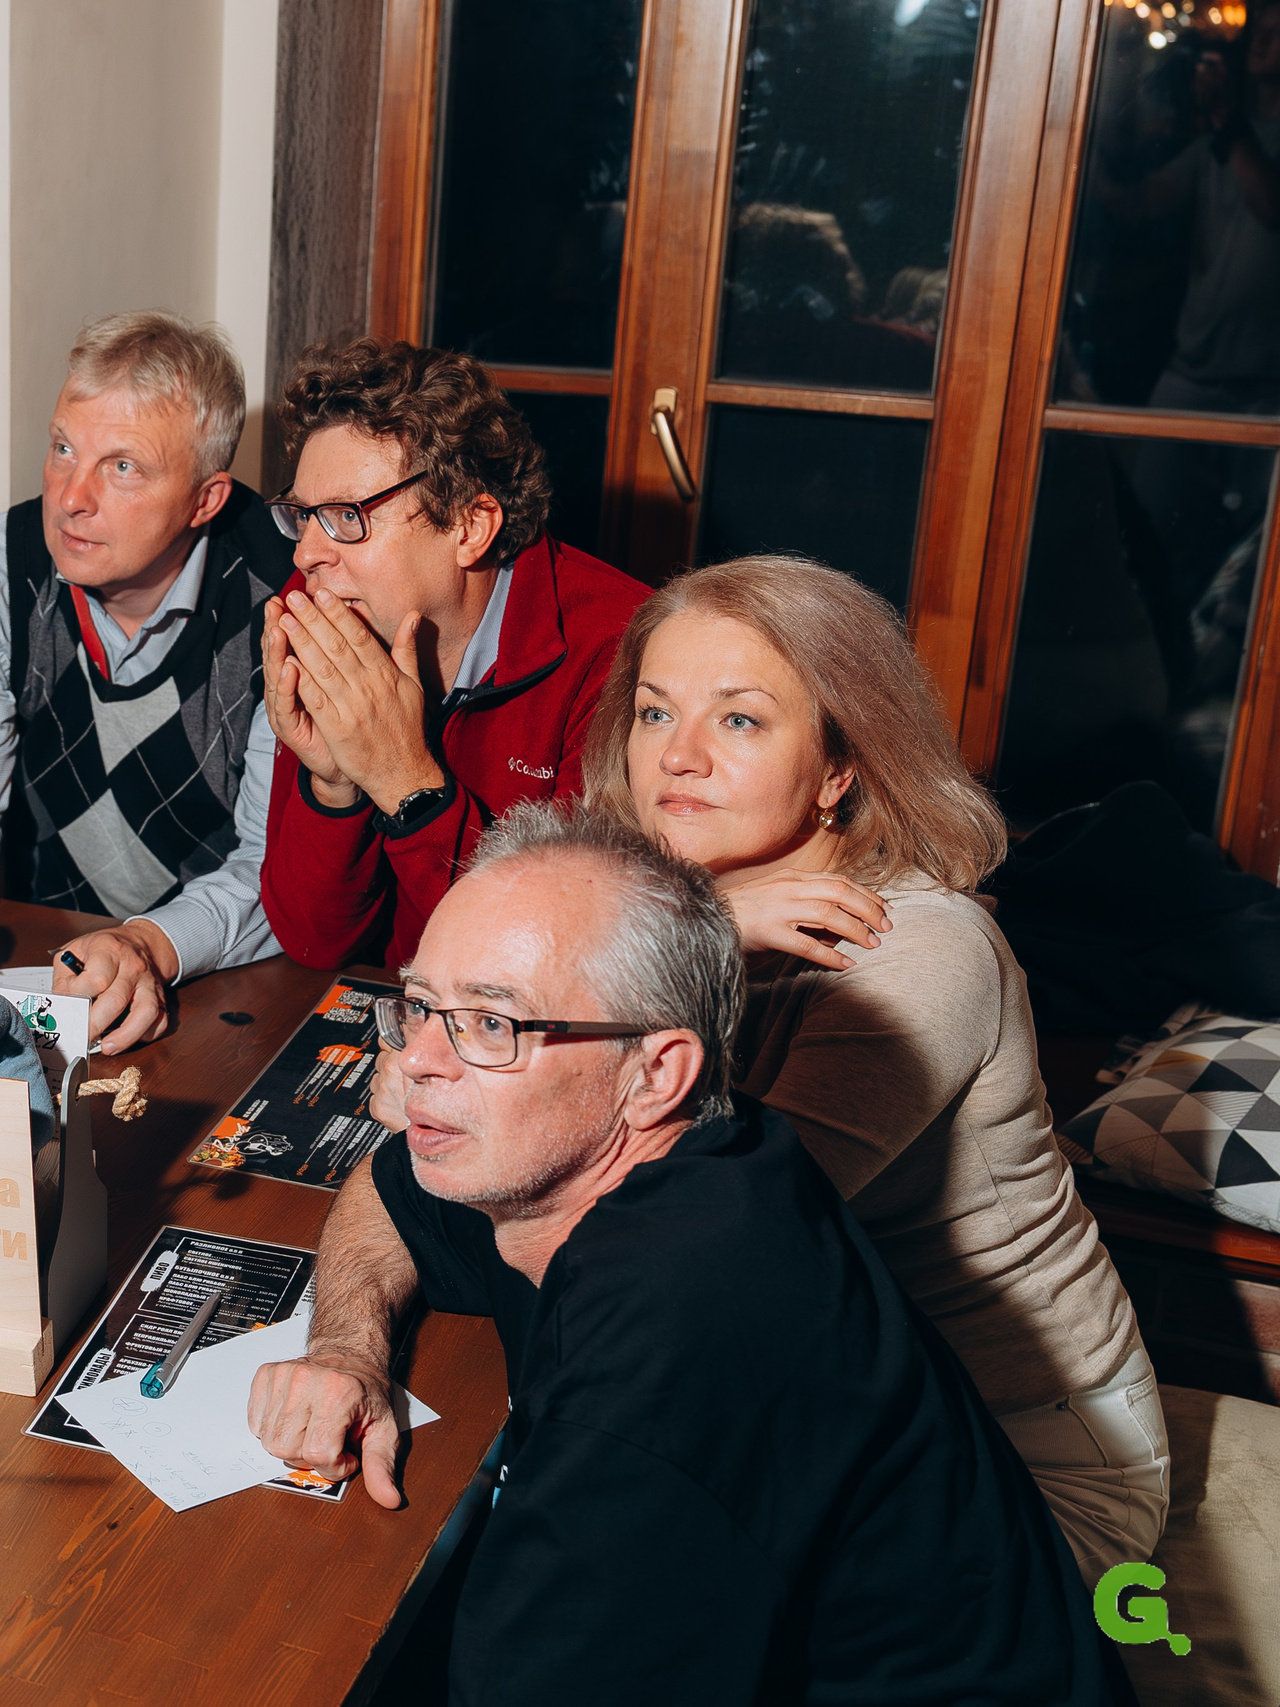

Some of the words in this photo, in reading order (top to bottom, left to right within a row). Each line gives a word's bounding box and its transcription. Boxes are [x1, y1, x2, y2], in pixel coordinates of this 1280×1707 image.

[516, 759, 554, 779] Columbi
[150, 1262, 170, 1281] ПИВО
[133, 1332, 177, 1345] НЕПРАВИЛЬНЫ
